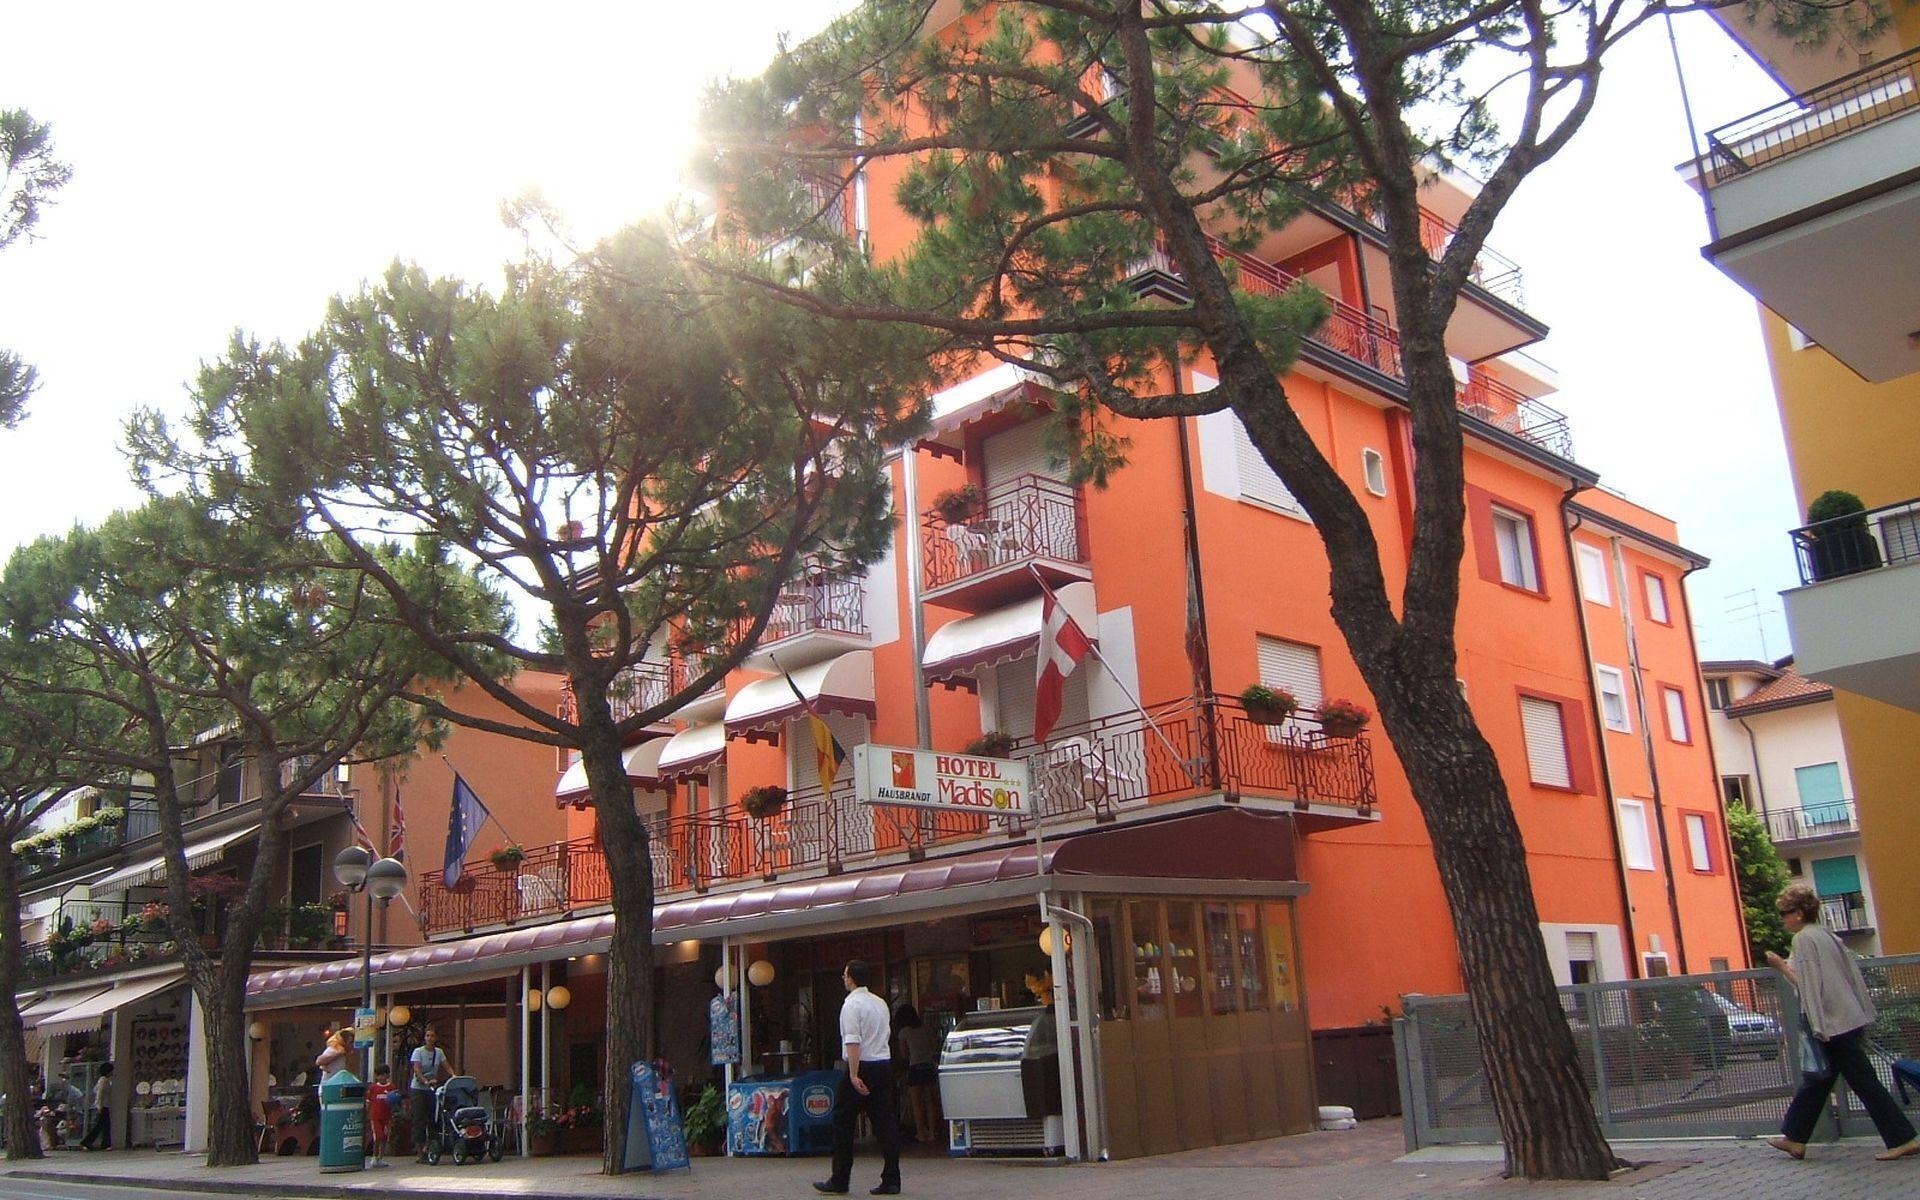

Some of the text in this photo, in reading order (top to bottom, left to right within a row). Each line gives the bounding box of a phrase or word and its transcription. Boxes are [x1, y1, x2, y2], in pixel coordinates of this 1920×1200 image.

[936, 756, 1001, 779] HOTEL
[878, 787, 931, 802] HAUSBRANDT
[937, 778, 1021, 810] Madison
